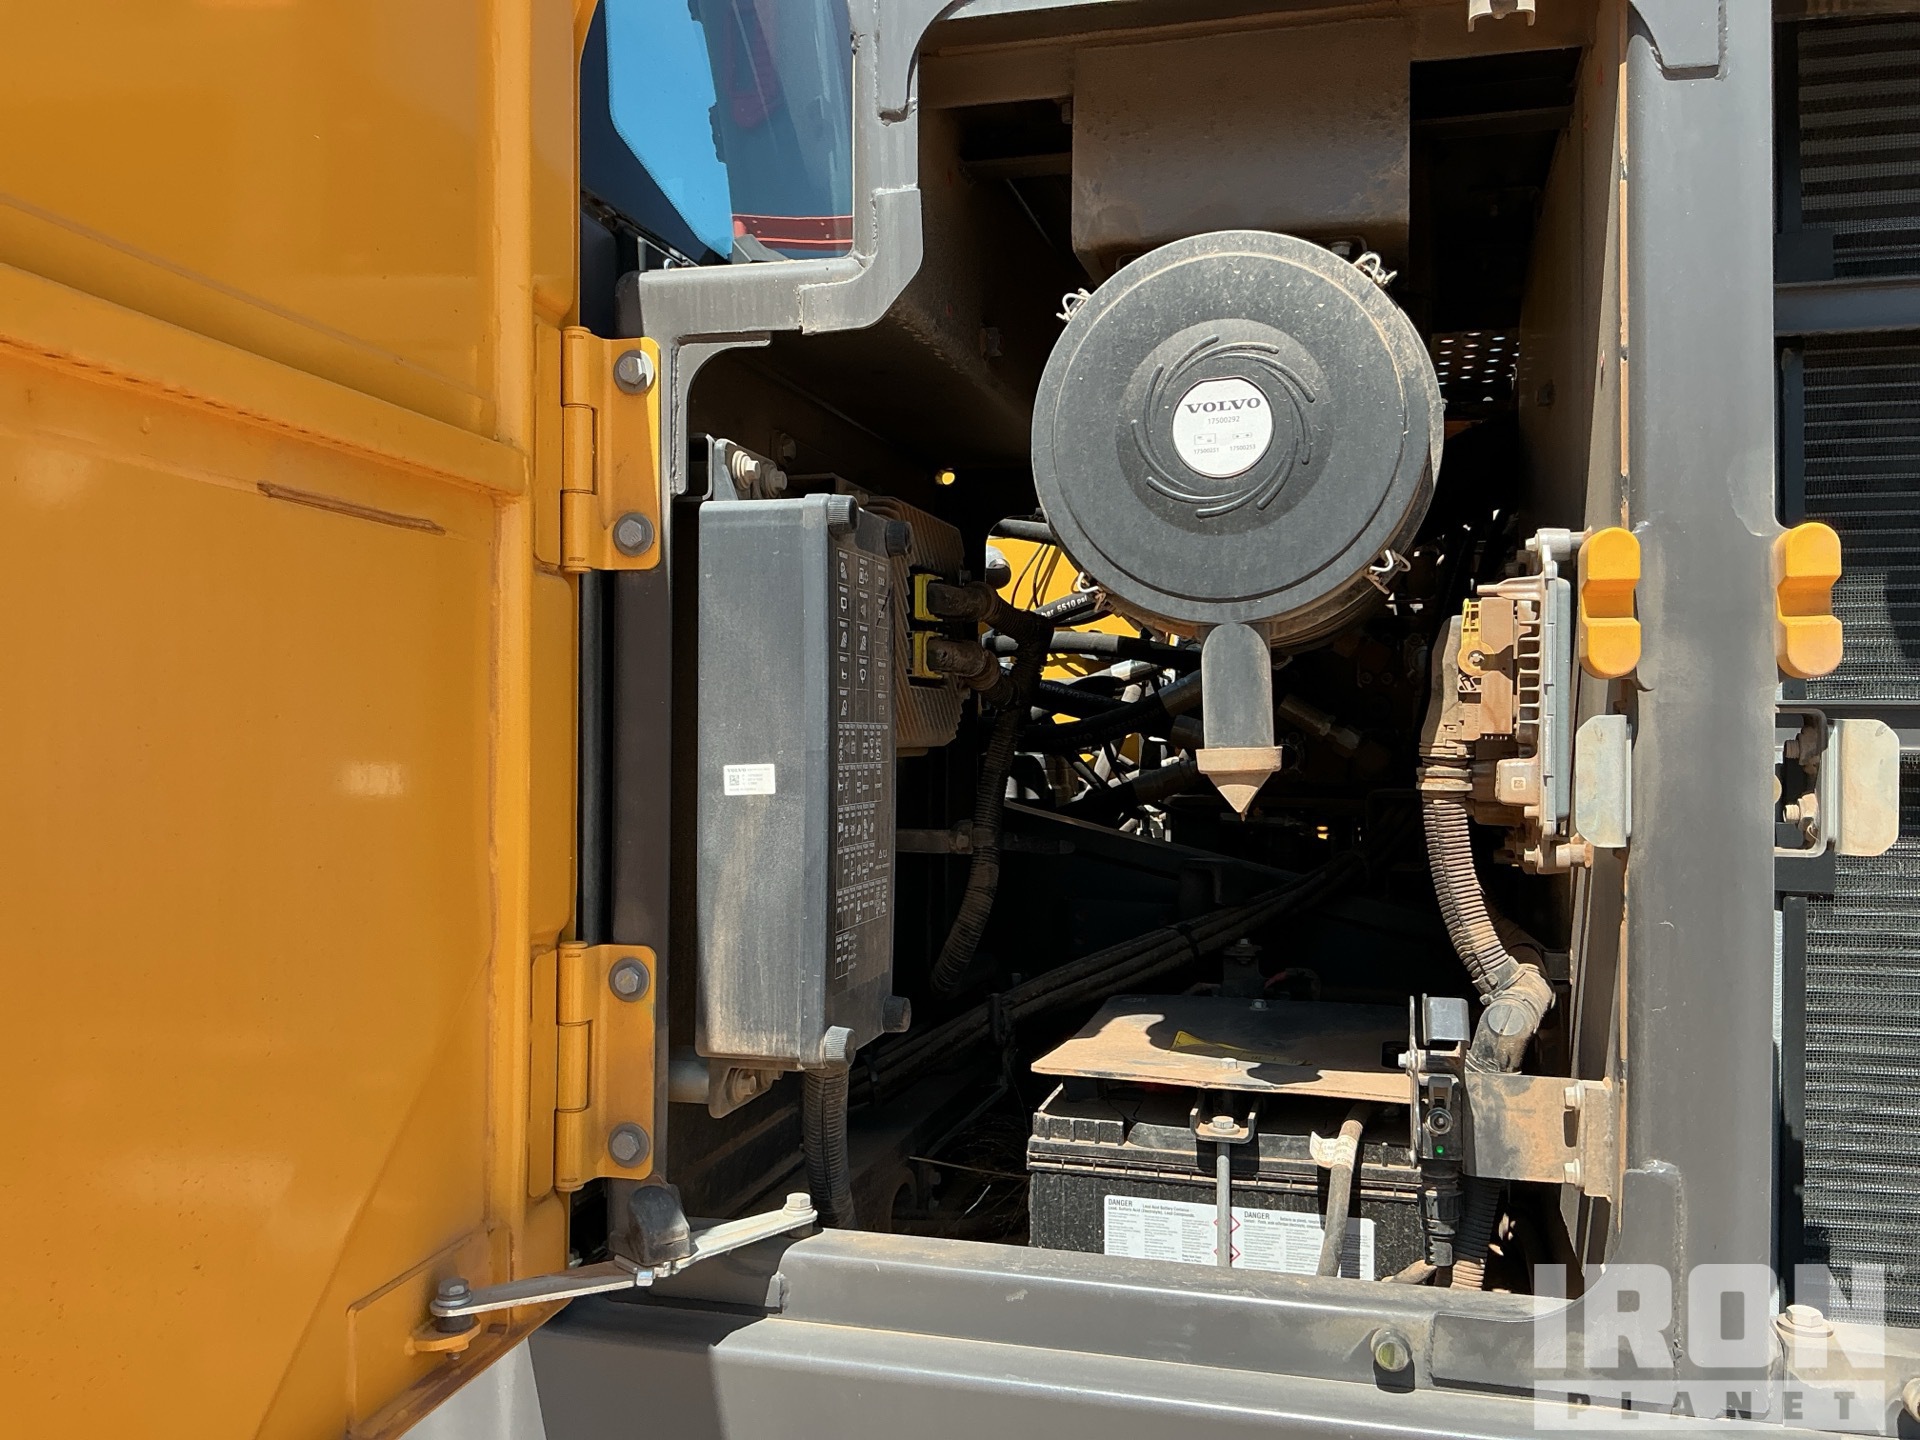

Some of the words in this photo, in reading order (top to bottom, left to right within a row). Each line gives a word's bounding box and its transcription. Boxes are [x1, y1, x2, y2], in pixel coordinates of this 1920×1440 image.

[1185, 398, 1261, 414] VOLVO
[1207, 416, 1240, 425] 17500292
[1056, 599, 1077, 612] 5510
[1108, 1198, 1133, 1207] DANGER
[1244, 1211, 1270, 1220] DANGER
